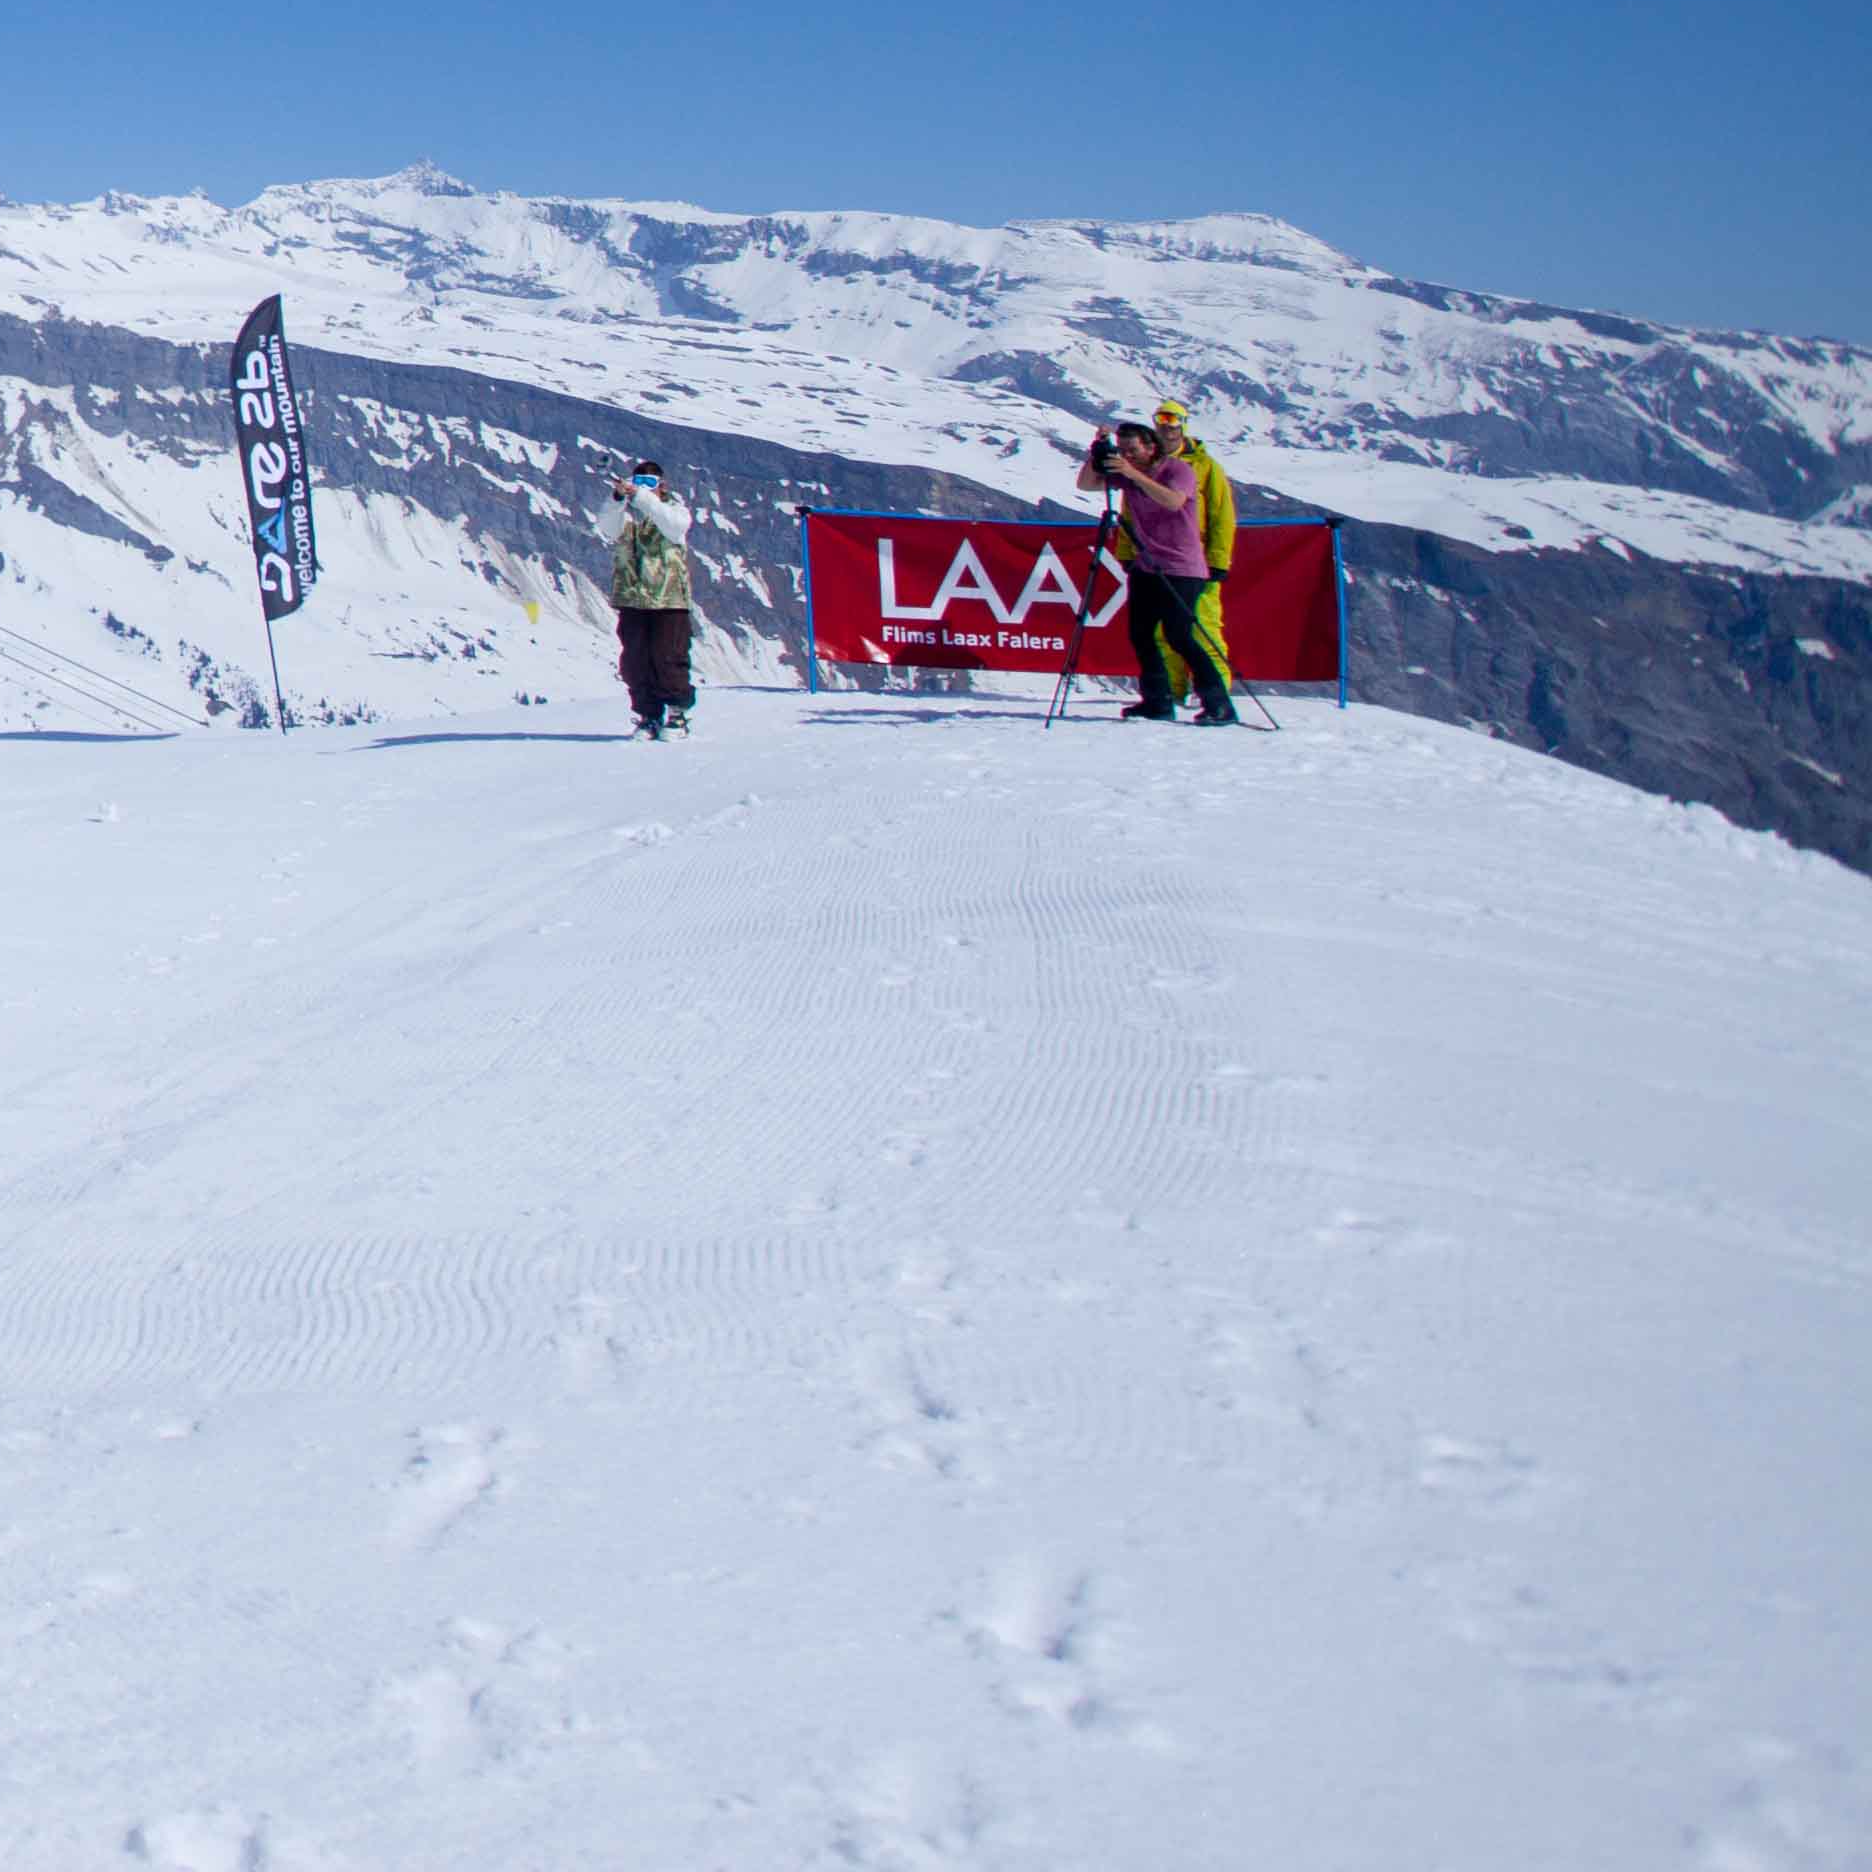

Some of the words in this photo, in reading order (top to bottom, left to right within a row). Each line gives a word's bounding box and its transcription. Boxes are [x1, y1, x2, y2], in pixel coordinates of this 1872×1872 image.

[236, 350, 275, 429] 2b
[267, 334, 298, 434] mountain
[287, 437, 302, 474] our
[290, 479, 305, 502] to
[881, 625, 937, 645] Flims
[942, 628, 992, 648] Laax
[997, 630, 1065, 651] Falera
